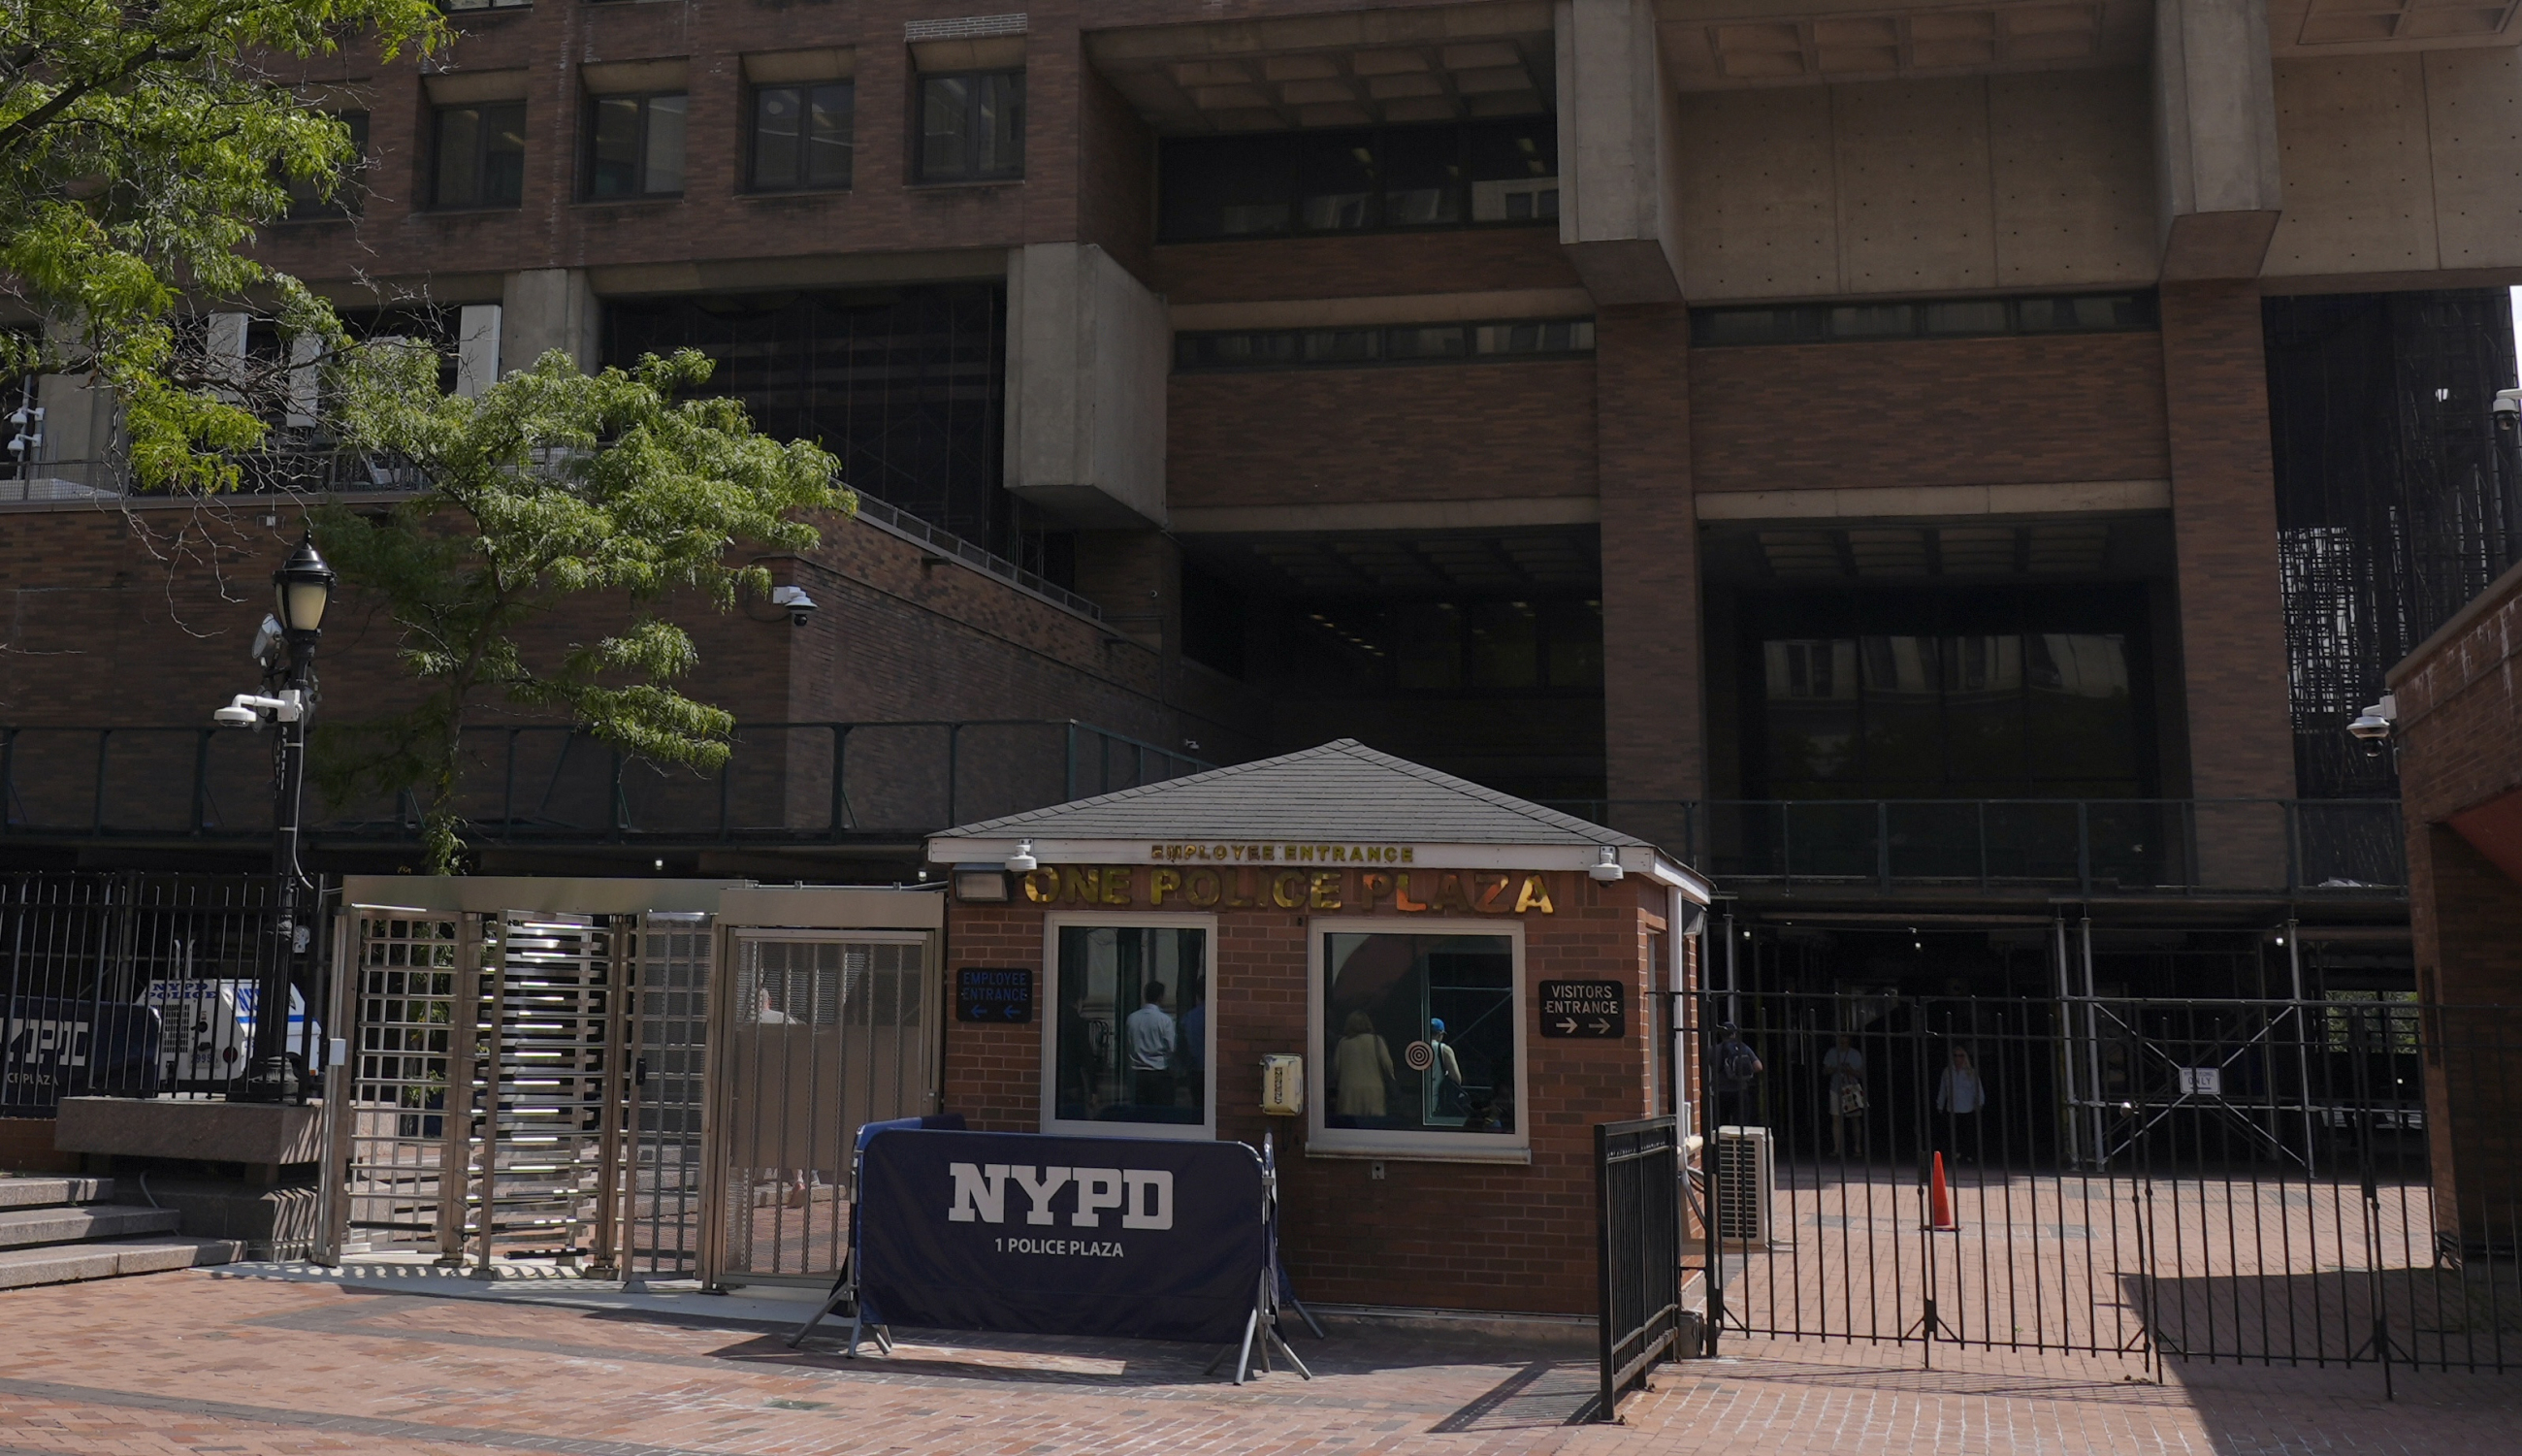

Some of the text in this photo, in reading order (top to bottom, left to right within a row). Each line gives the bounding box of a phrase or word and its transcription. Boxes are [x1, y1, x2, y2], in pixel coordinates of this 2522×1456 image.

[1151, 845, 1413, 862] EMPLOYEE ENTRANCE
[1023, 866, 1556, 915] ONE POLICE PLAZA
[963, 972, 1027, 985] EMPLOYEE
[153, 983, 209, 991] NYPD
[962, 987, 1027, 1000] ENTRANCE
[1551, 985, 1613, 998] VISITORS
[148, 991, 219, 1000] POLICE
[1545, 1000, 1619, 1015] ENTRANCE
[948, 1161, 1174, 1231] NYPD
[995, 1237, 1125, 1258] 1 POLICE PLAZA
